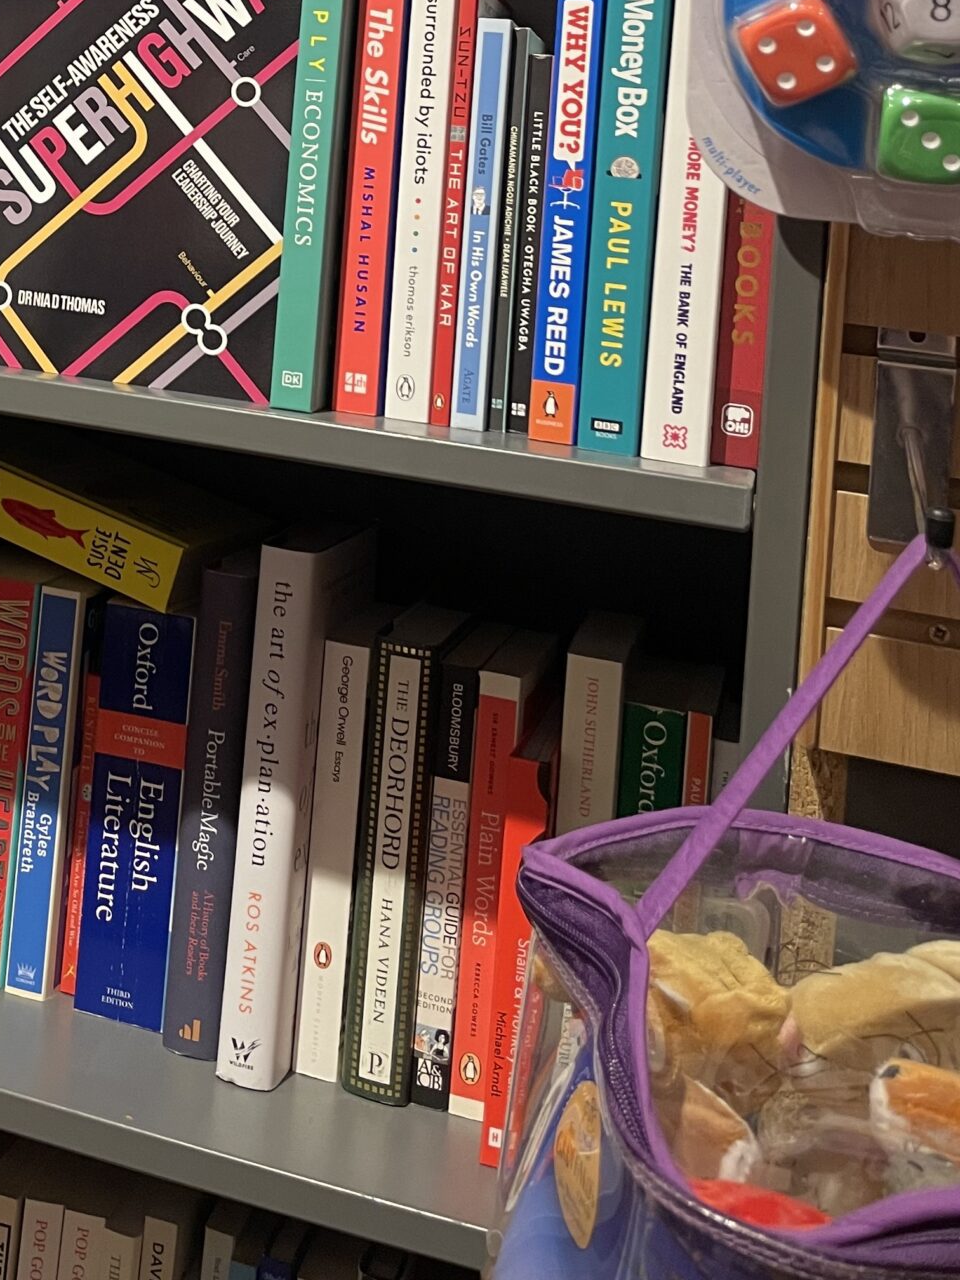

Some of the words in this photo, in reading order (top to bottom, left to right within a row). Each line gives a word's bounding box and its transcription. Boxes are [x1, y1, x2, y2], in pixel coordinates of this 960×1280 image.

[365, 9, 393, 57] The
[2, 103, 40, 142] THE
[361, 64, 388, 145] Skills
[420, 108, 434, 127] by
[615, 83, 649, 139] Box
[413, 135, 428, 184] idiots
[358, 166, 375, 241] MISHAL
[548, 215, 574, 298] JAMES
[605, 200, 632, 270] PAUL
[177, 251, 208, 288] Behaviour
[354, 255, 367, 333] HUSAIN
[679, 263, 692, 287] THE
[600, 281, 628, 368] LEWIS
[676, 292, 690, 327] BANK
[544, 307, 568, 377] REED
[675, 330, 687, 351] OF
[671, 353, 687, 414] ENGLAND
[87, 529, 112, 570] SUSIE
[103, 533, 132, 579] DENT
[134, 622, 161, 709] Oxford
[447, 683, 464, 772] BLOOMSBURY
[95, 772, 131, 922] Literature
[131, 777, 165, 892] English
[245, 892, 262, 935] ROS
[239, 940, 260, 1015] ATKINS
[495, 1011, 510, 1063] Michael
[490, 1064, 504, 1098] Arndt
